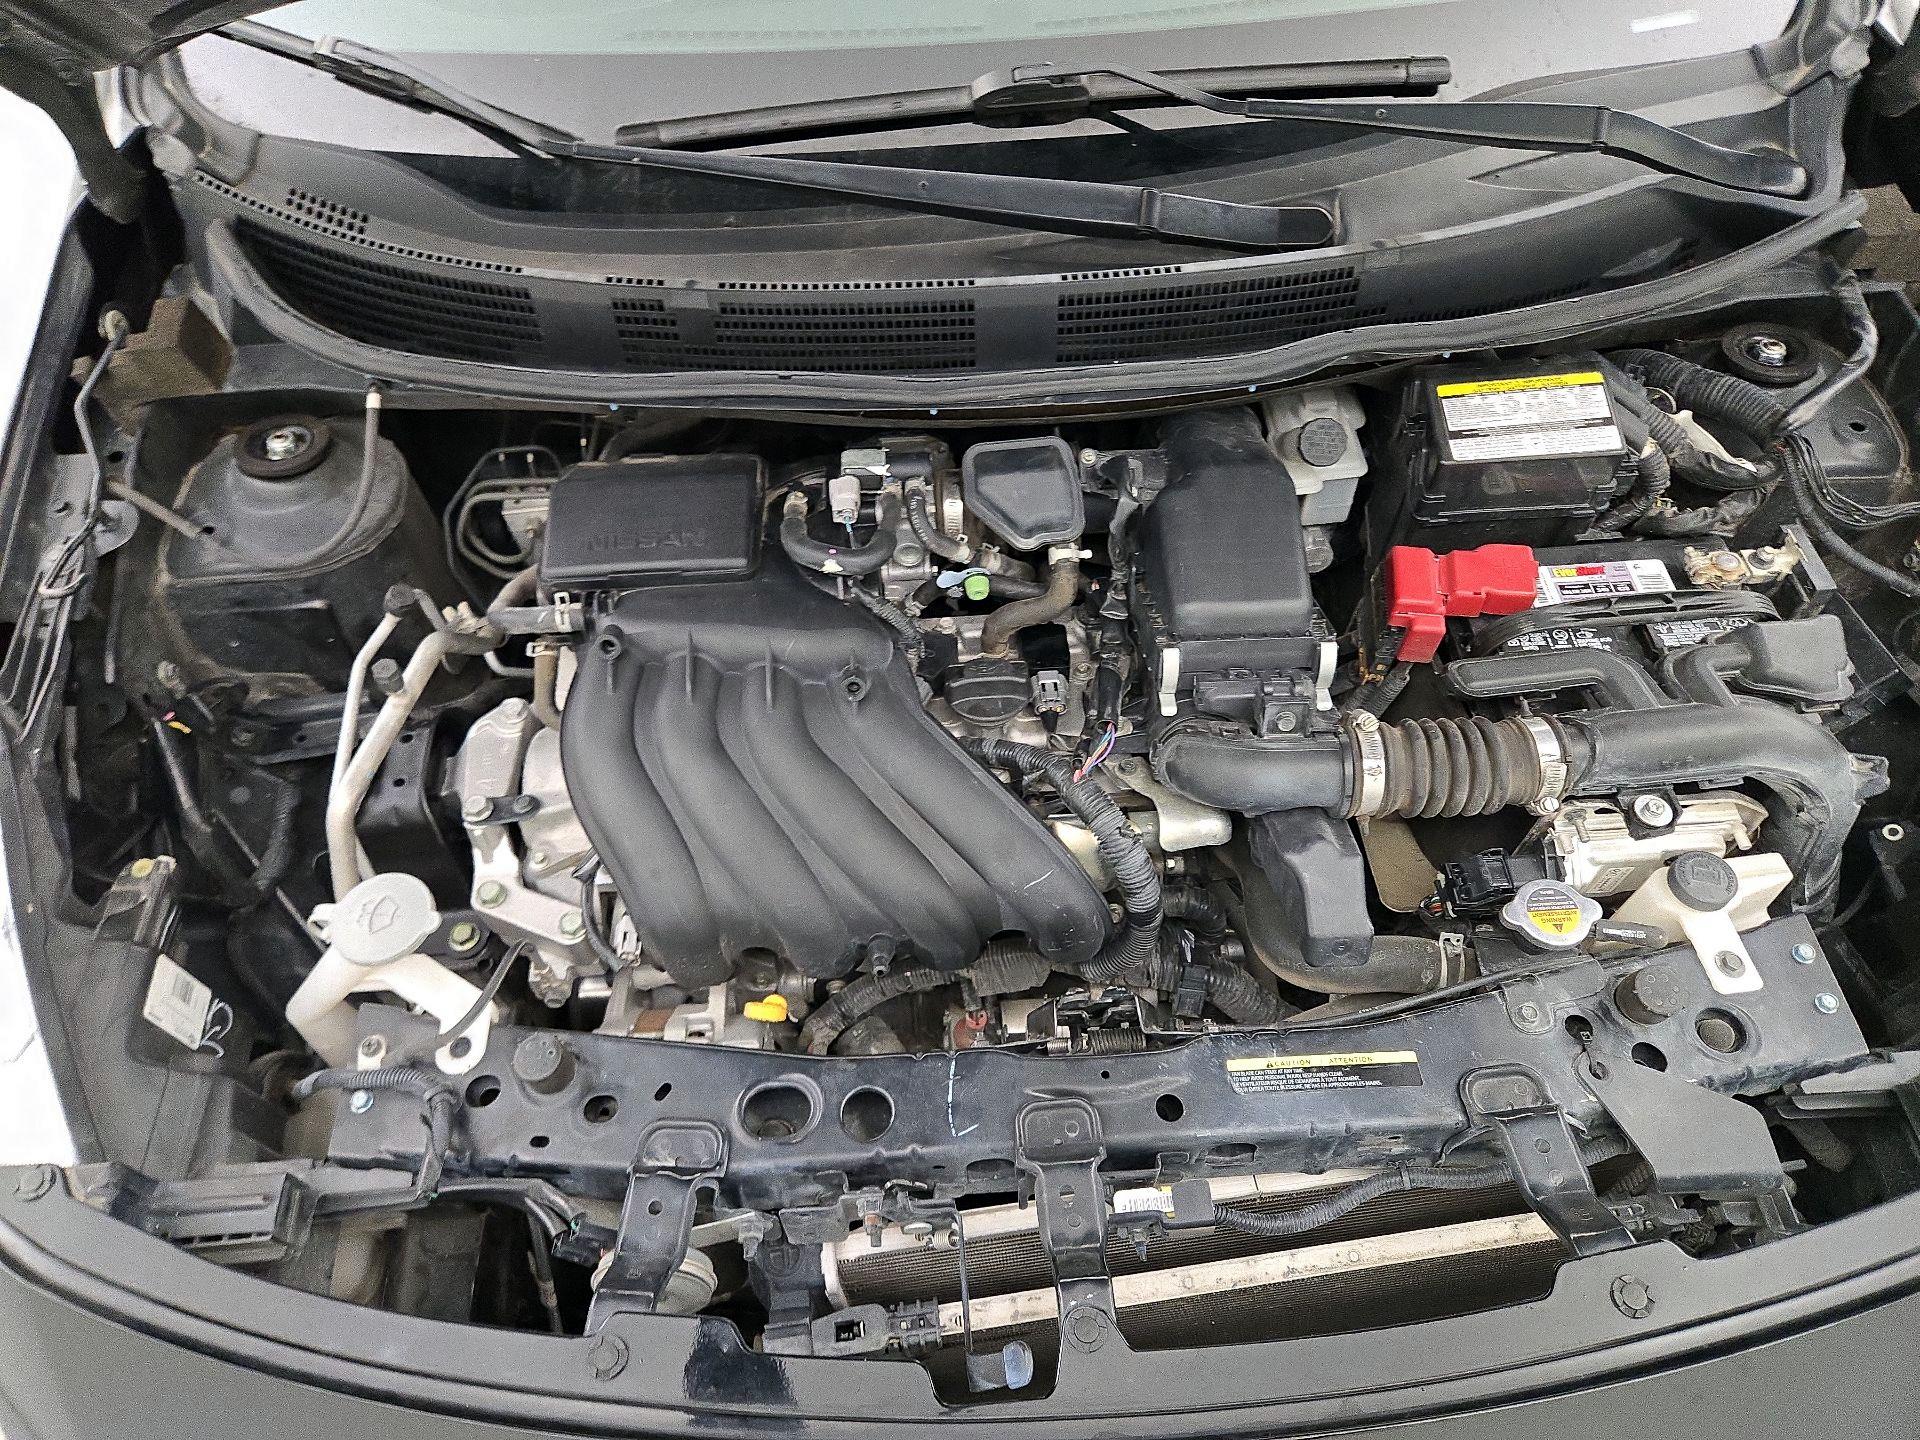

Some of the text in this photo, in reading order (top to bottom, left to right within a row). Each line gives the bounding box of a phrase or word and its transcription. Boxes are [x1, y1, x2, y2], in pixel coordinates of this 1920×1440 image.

[587, 531, 706, 551] NISSAN
[1540, 916, 1573, 924] WARNING
[1274, 1059, 1311, 1067] CAUTION
[1328, 1056, 1373, 1064] ATTENTION
